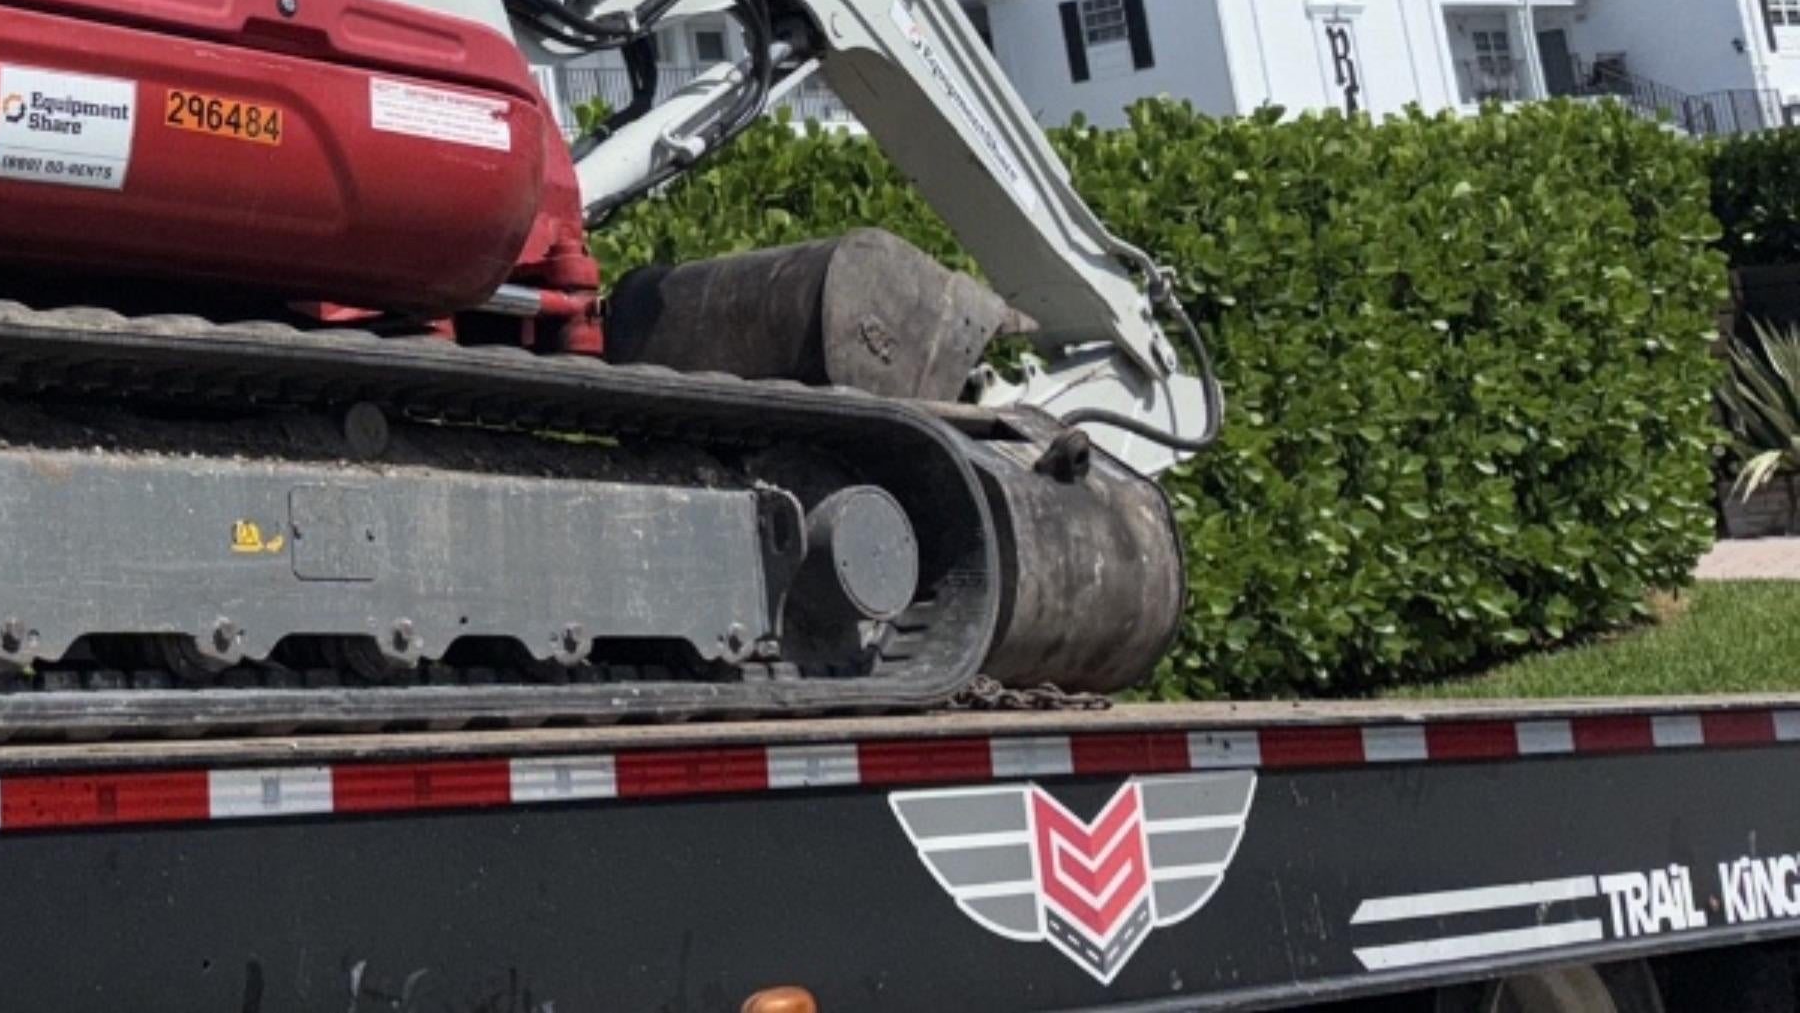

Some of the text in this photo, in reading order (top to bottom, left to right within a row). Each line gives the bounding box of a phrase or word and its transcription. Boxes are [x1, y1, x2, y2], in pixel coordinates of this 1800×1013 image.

[30, 91, 129, 120] Equipment
[167, 91, 280, 141] 296484
[27, 113, 83, 135] Share
